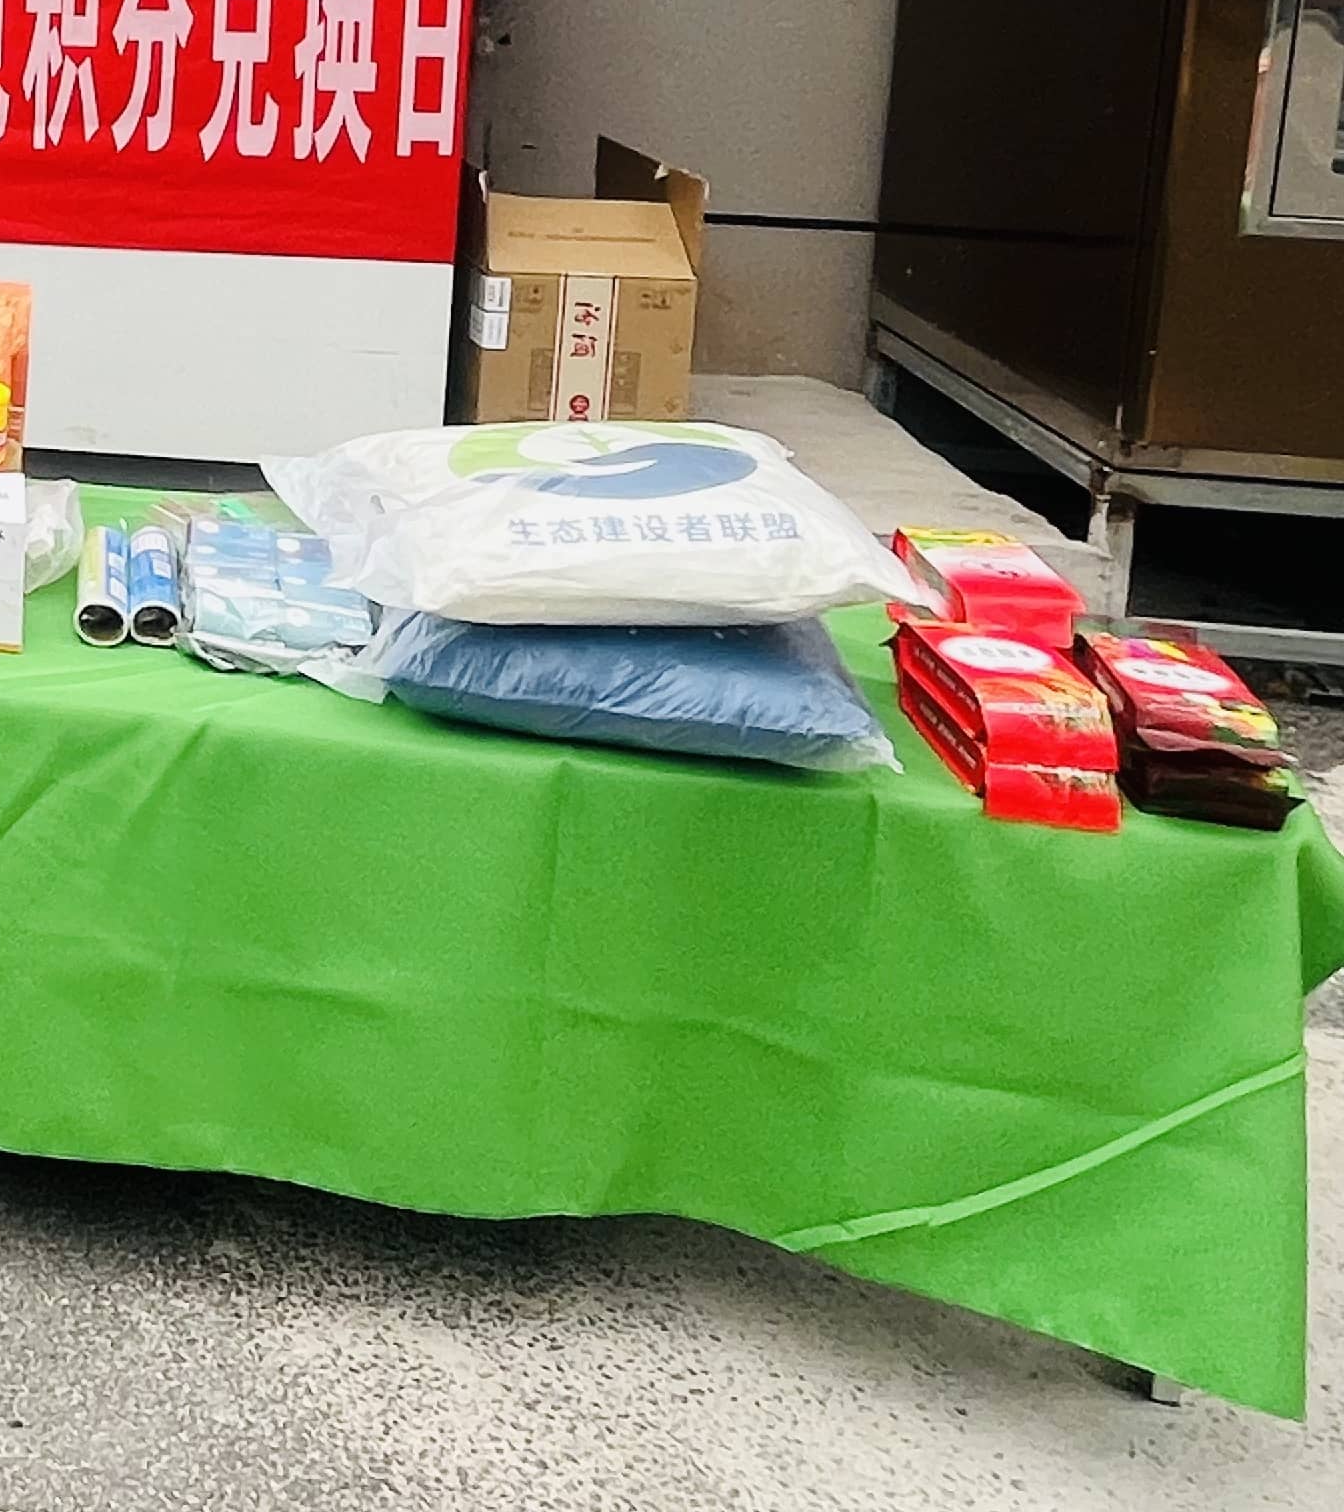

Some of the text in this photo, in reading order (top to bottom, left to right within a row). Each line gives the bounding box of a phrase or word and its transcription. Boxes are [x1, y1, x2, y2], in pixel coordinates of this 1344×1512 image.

[507, 512, 800, 547] 生态建设者联盟
